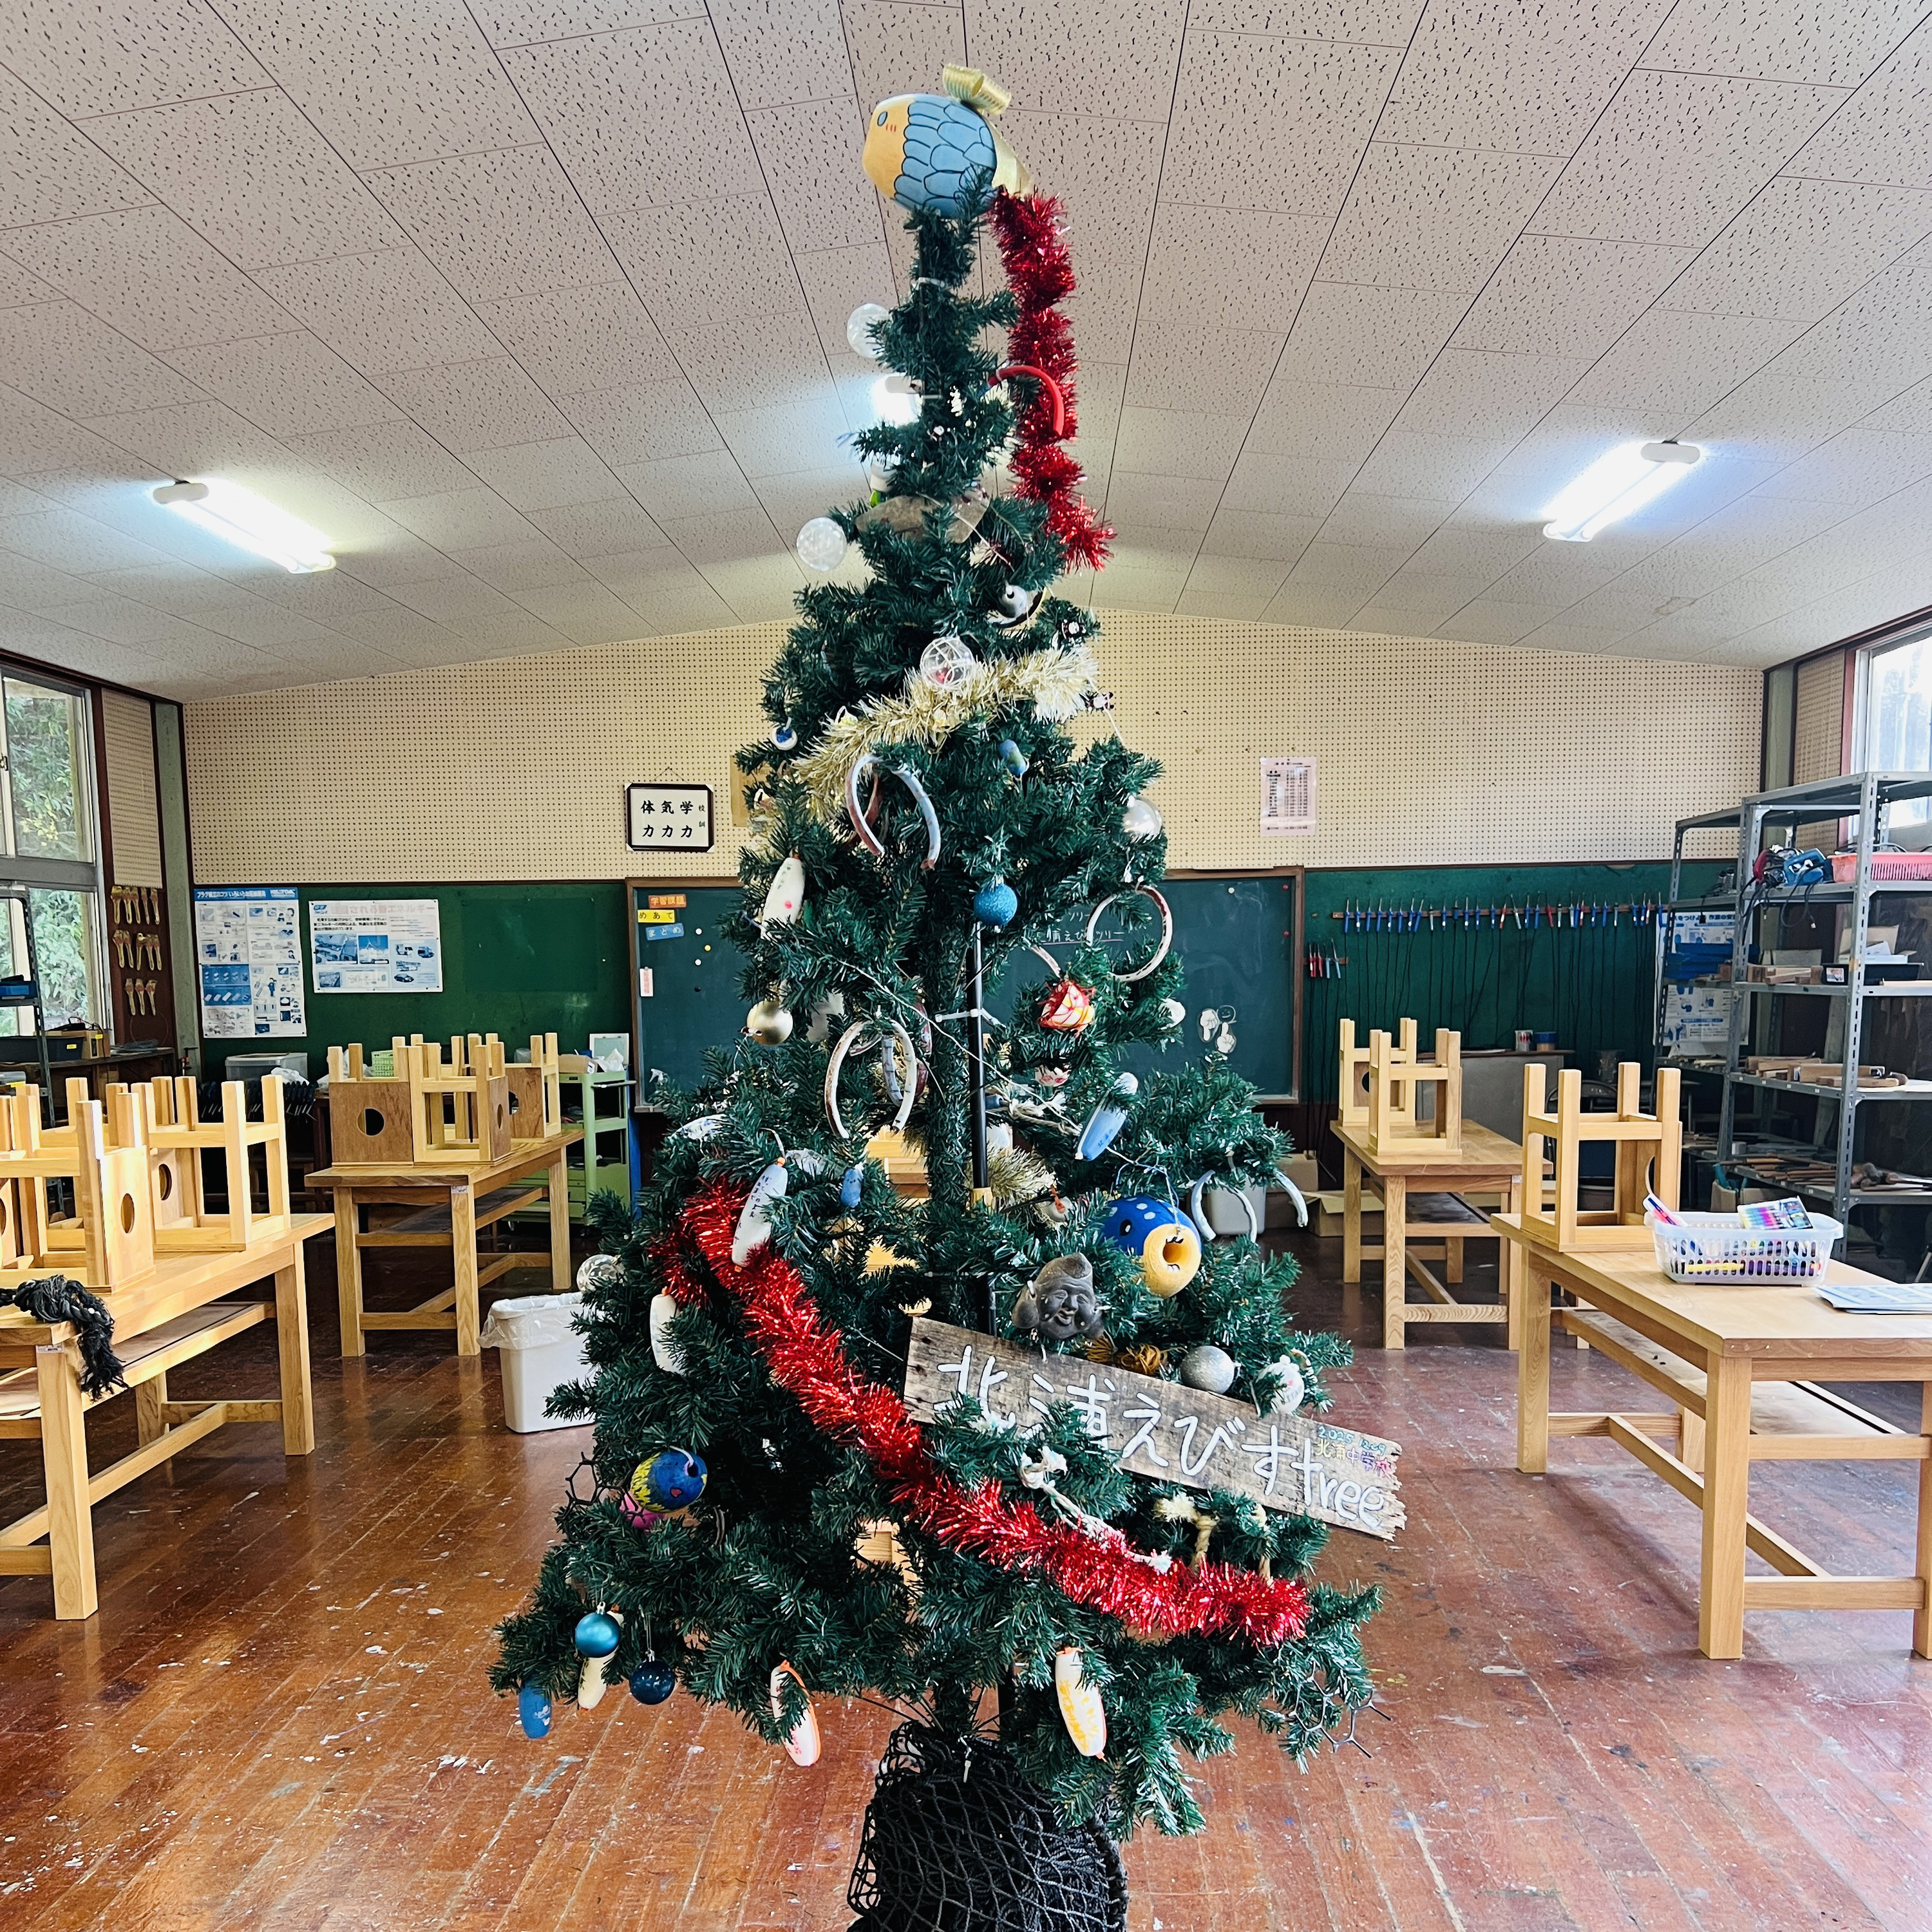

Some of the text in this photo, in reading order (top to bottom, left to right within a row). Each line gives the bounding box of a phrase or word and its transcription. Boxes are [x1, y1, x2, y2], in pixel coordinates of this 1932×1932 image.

[640, 800, 656, 838] 体力
[660, 800, 675, 838] 気力
[679, 800, 694, 838] 学力
[639, 911, 674, 920] めあて
[1318, 1426, 1355, 1444] 2025
